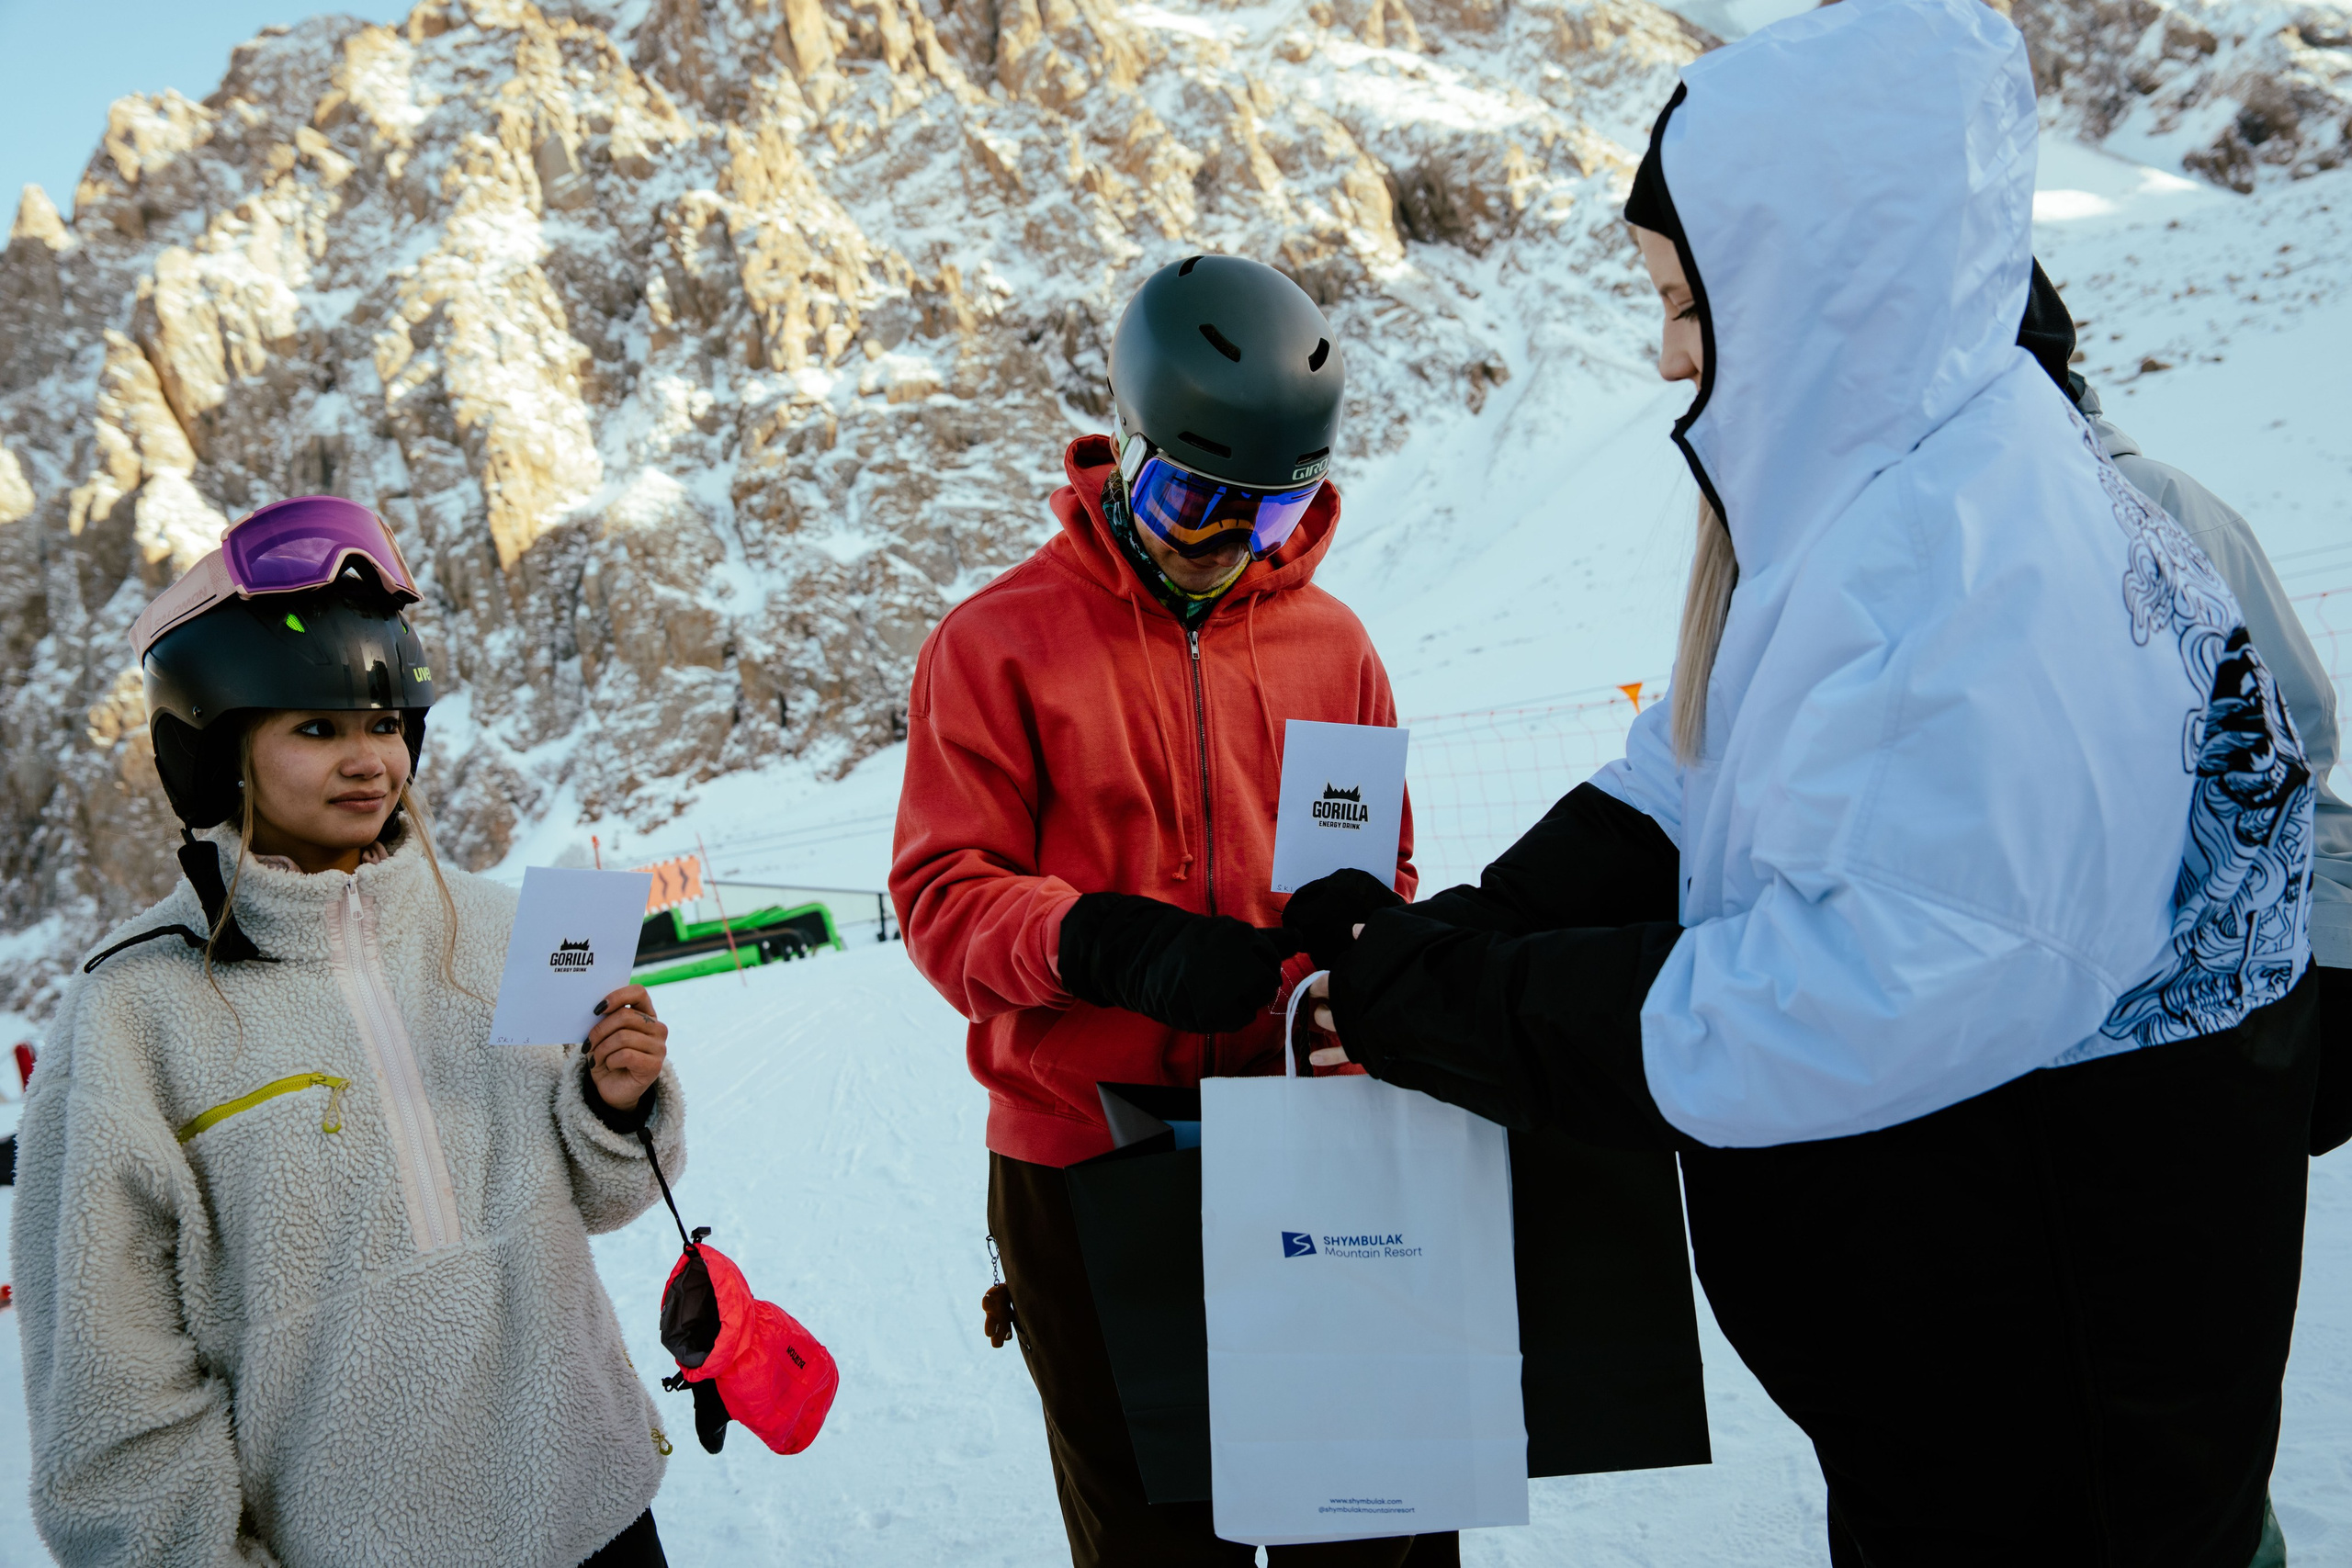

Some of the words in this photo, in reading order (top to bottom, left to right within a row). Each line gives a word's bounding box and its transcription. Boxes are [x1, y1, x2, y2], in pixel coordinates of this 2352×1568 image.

[1292, 457, 1329, 480] GIRO
[154, 585, 208, 629] SALOMON
[1312, 800, 1369, 822] GORILLA
[1318, 820, 1341, 829] ENERGY
[549, 952, 594, 965] GORILLA
[1323, 1234, 1403, 1247] SHYMBULAK
[1324, 1247, 1381, 1258] Mountain
[1385, 1246, 1422, 1258] Resort
[1329, 1497, 1403, 1506] www.shymbulak.com
